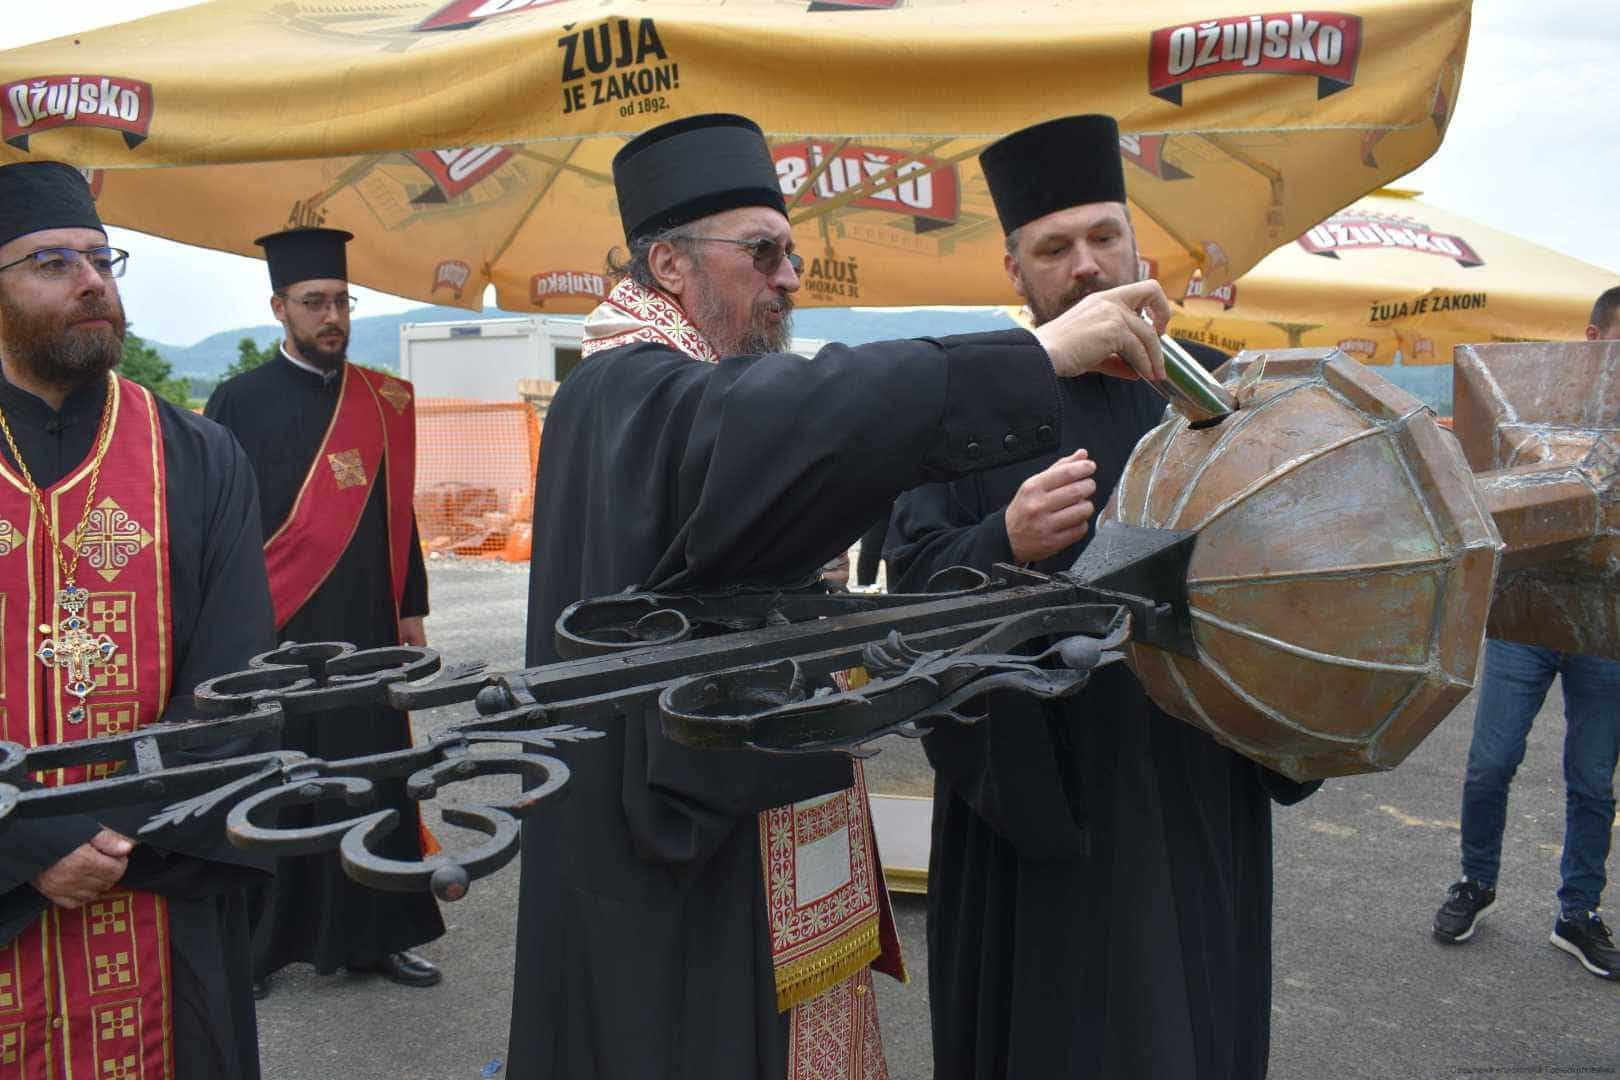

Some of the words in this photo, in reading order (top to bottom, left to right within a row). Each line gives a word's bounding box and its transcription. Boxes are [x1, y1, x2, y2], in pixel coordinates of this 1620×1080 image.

[557, 18, 668, 83] ŽUJA
[1167, 13, 1343, 76] Ožujsko
[8, 77, 140, 127] Ožujsko
[563, 84, 587, 114] JE
[591, 63, 680, 106] ZAKON!
[620, 102, 634, 117] od
[638, 97, 671, 114] 1892.
[1369, 300, 1409, 322] ŽUJA
[1410, 301, 1428, 316] JE
[1431, 292, 1488, 313] ZAKON!
